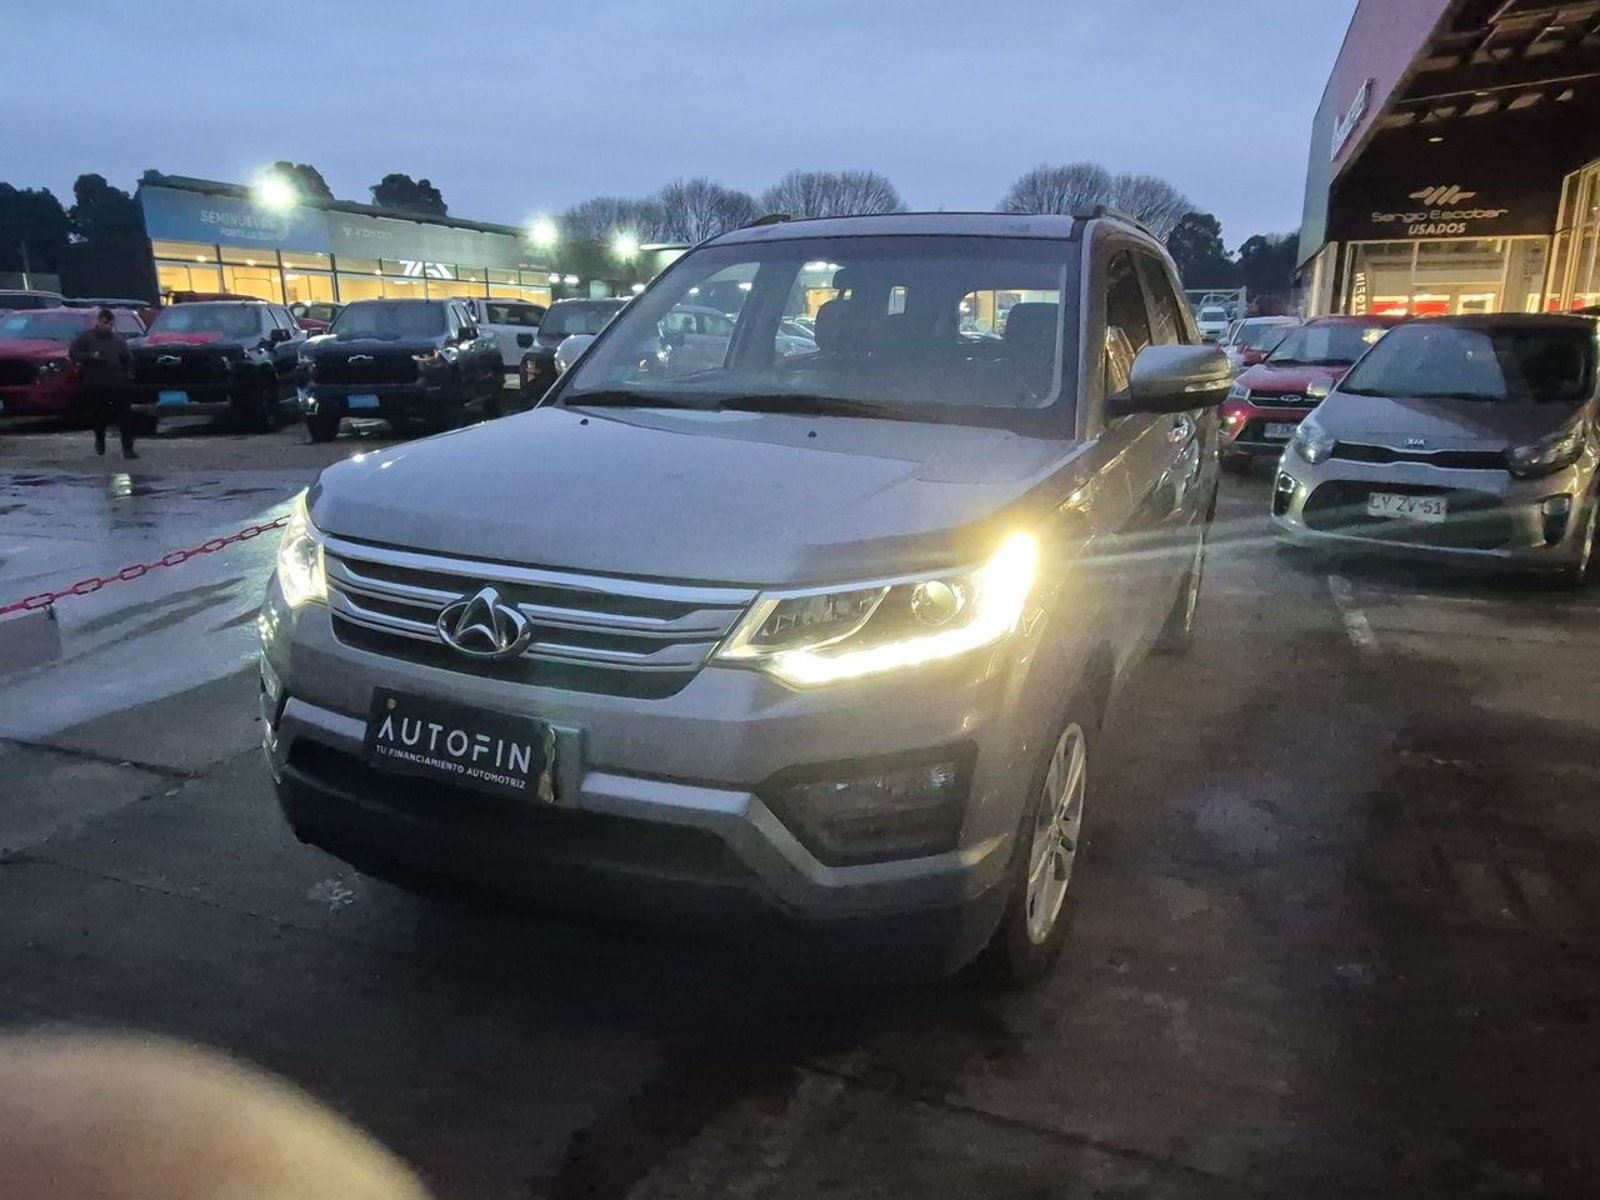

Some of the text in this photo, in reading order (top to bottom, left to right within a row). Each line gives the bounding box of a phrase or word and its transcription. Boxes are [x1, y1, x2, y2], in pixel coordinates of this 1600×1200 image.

[1408, 222, 1467, 235] USADOS
[1429, 209, 1509, 220] Escobar
[378, 714, 531, 774] AUTOFIN
[376, 744, 526, 789] TU FINANCIAMIENTO AUTOMOTRIZ
